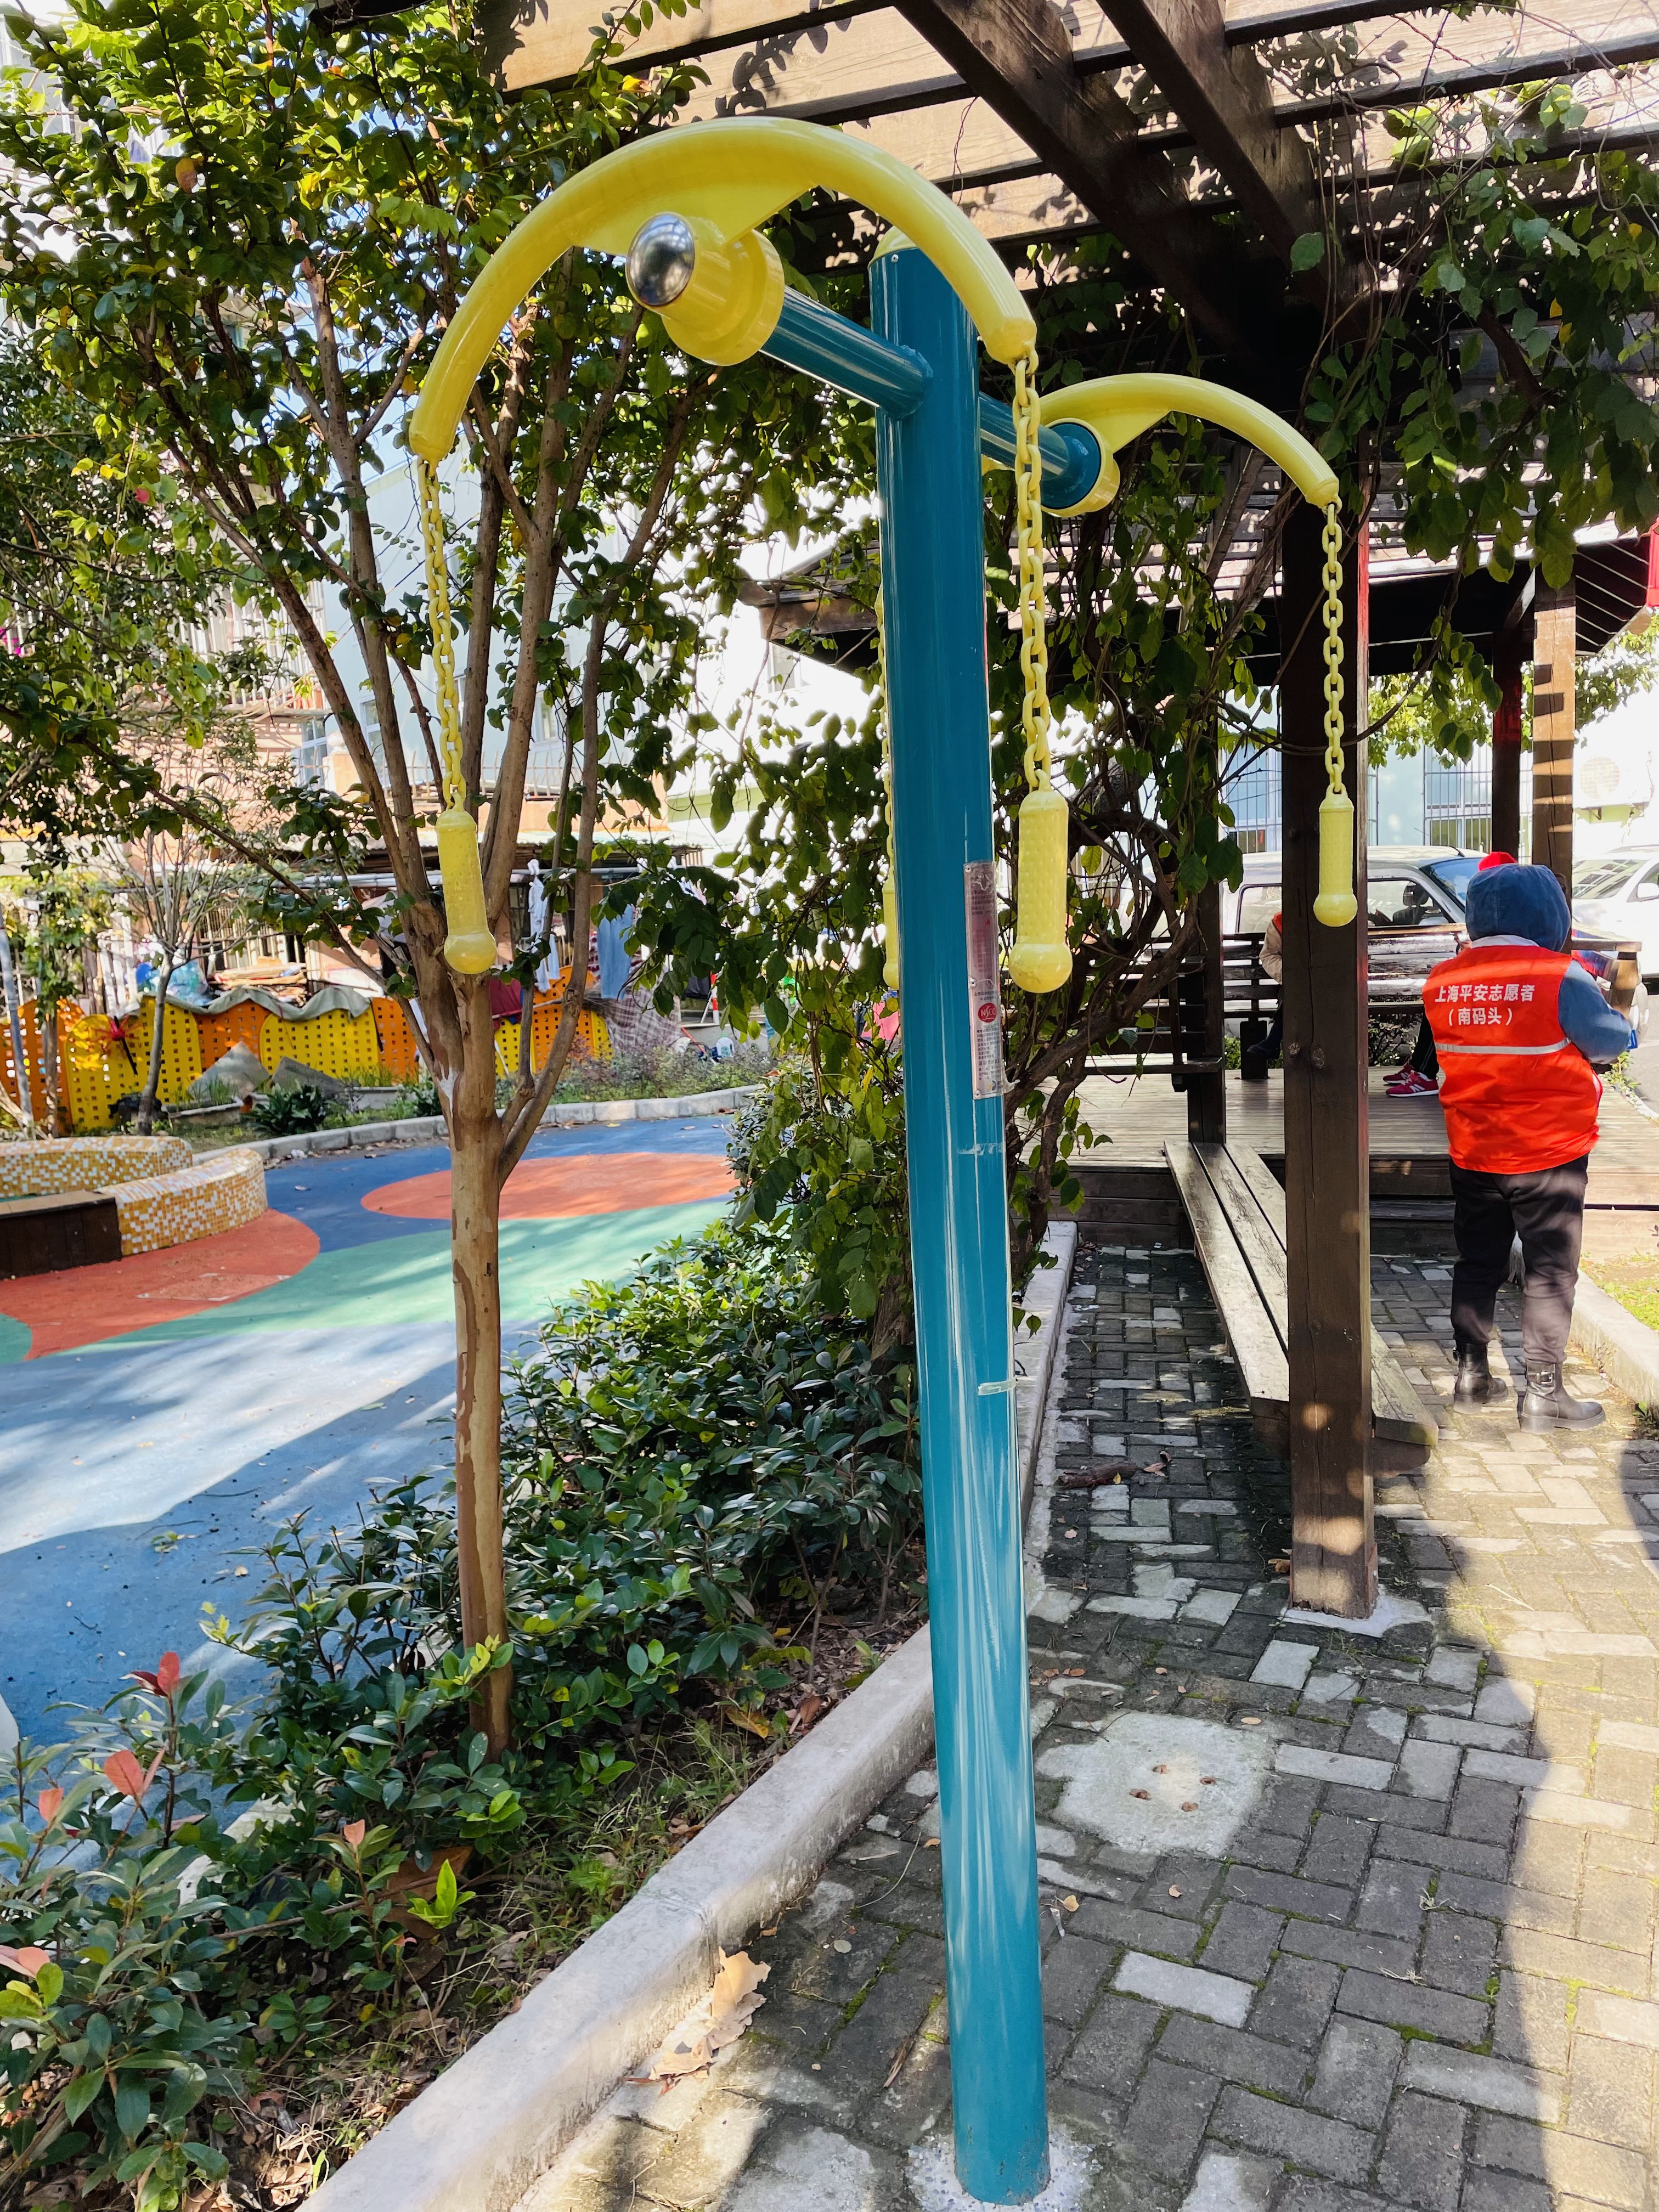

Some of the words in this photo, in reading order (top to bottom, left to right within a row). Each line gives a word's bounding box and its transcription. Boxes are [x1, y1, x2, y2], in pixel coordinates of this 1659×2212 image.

[1435, 984, 1535, 1002] 上海平安志愿者
[1448, 1007, 1513, 1026] （南码头）
